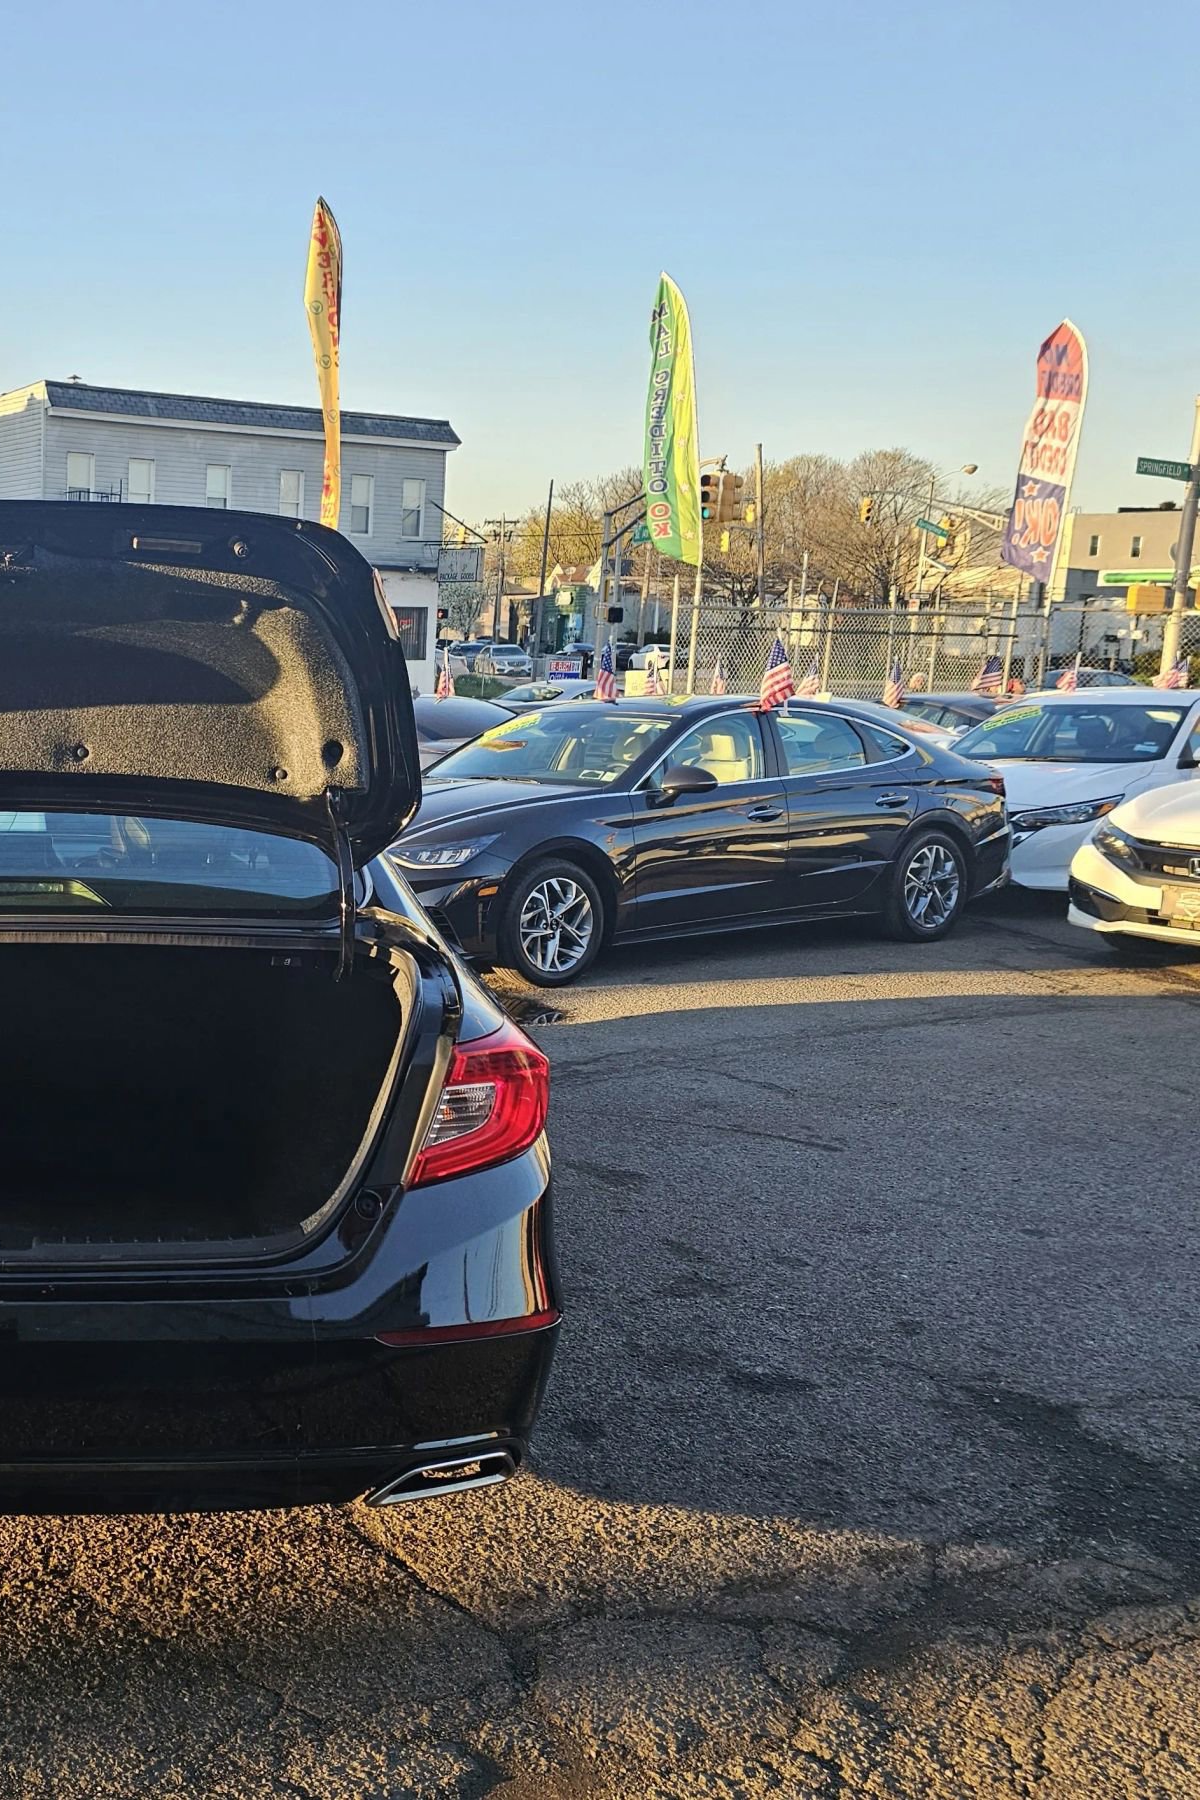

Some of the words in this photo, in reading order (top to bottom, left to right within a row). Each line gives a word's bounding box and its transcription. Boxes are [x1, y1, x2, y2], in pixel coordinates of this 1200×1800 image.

[1139, 460, 1182, 476] SPRINGFIELD
[440, 572, 458, 580] PACKAGE
[460, 572, 475, 580] GOODS
